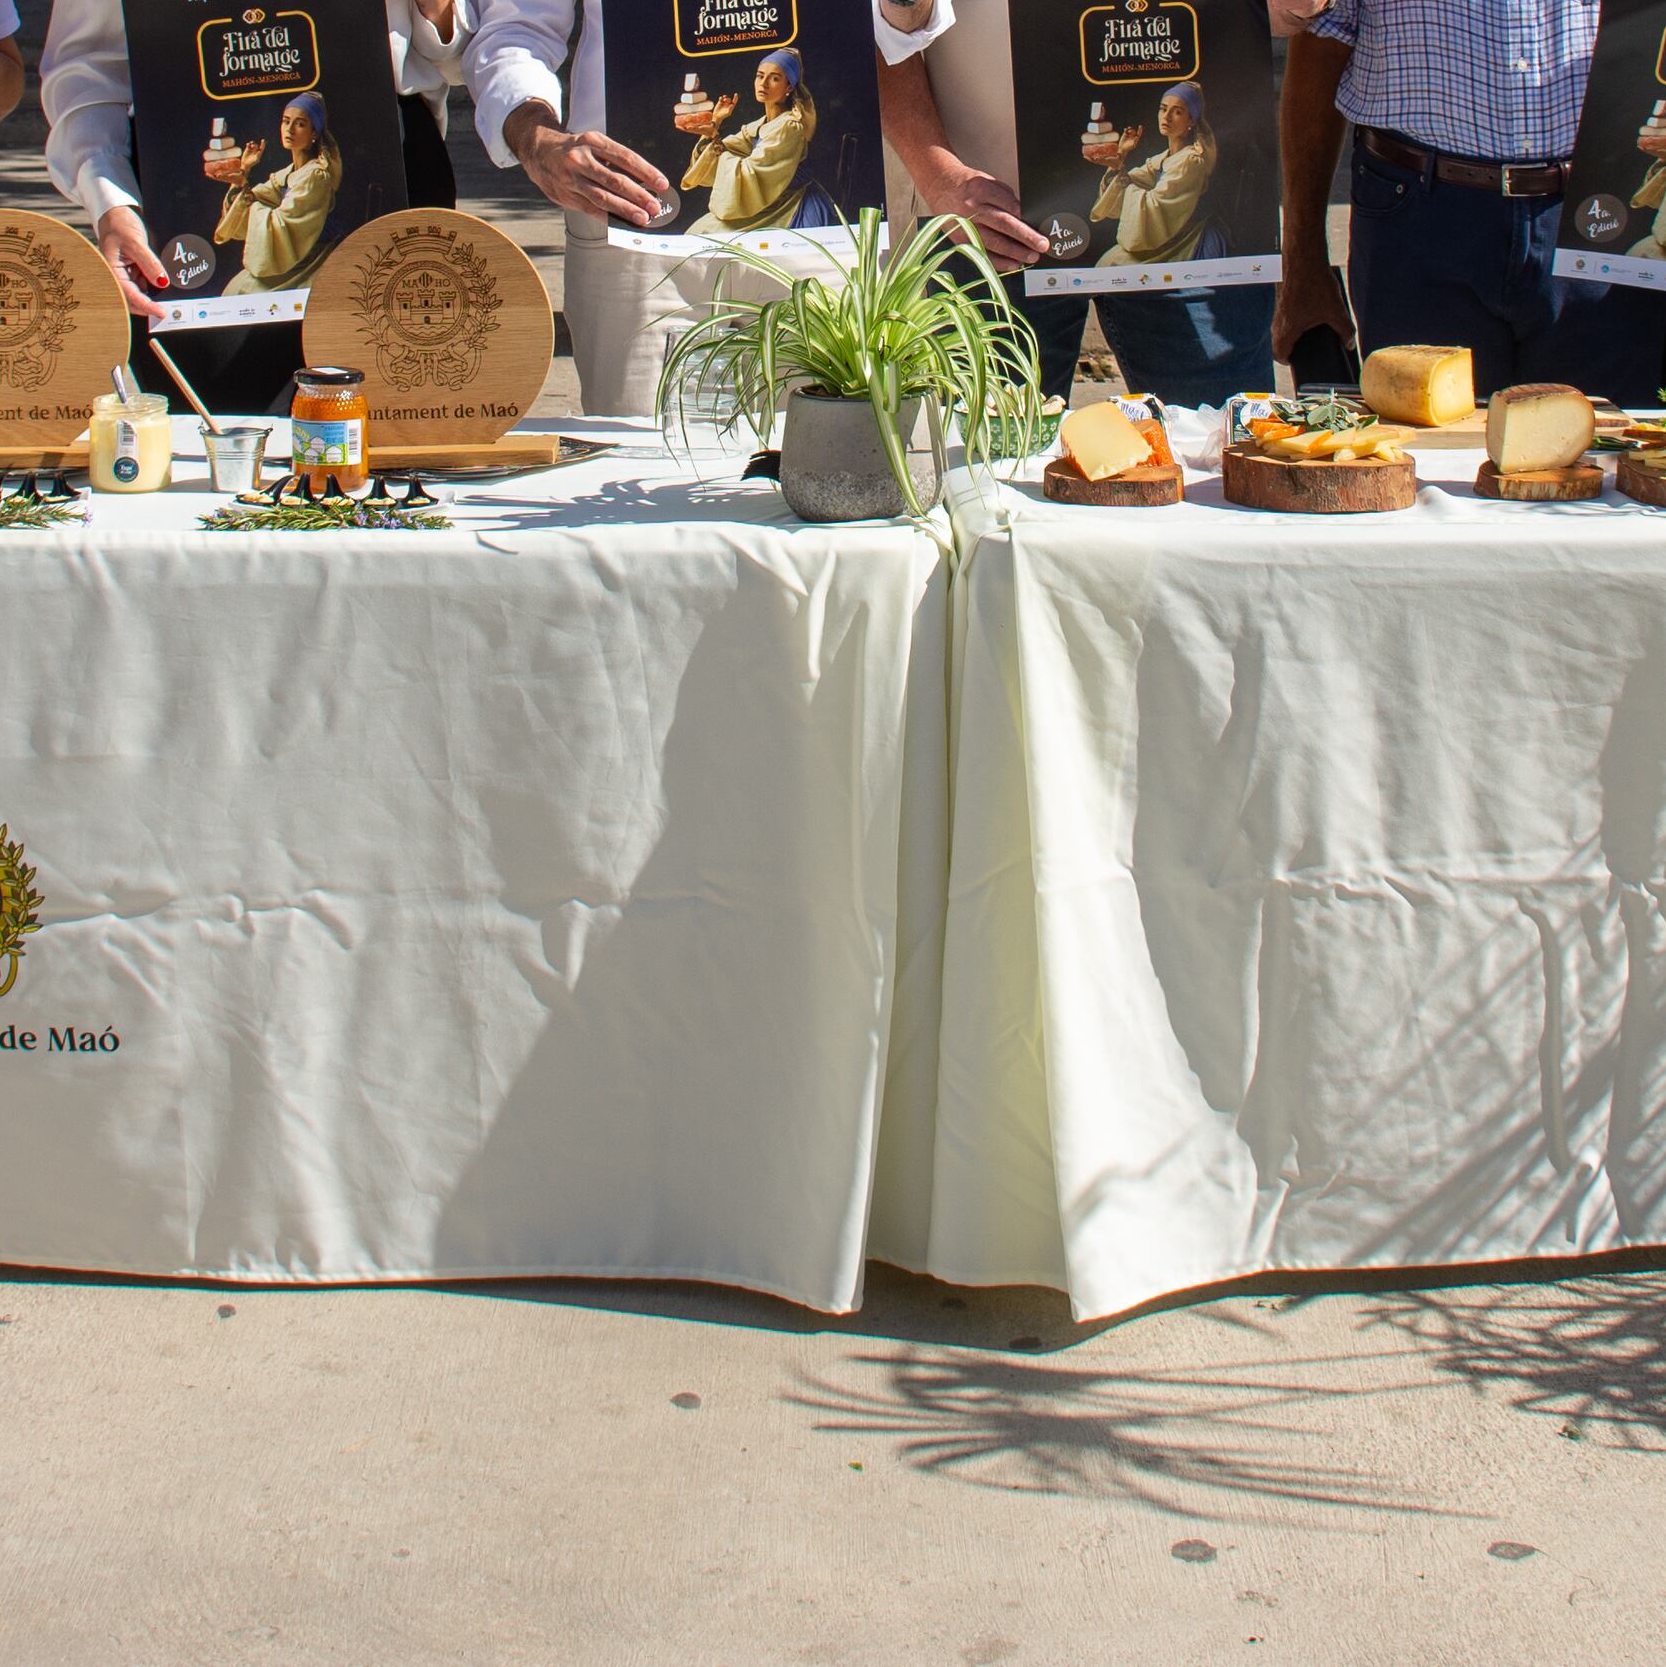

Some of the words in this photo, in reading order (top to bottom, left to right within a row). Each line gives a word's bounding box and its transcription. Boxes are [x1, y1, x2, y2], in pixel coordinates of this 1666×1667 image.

[694, 7, 778, 35] formatge
[1105, 18, 1142, 41] Fira
[1144, 16, 1170, 36] del
[223, 30, 261, 53] Fira
[262, 26, 290, 48] del
[697, 30, 778, 45] MAHÓN-MENORCA
[1100, 37, 1180, 62] formatge
[220, 48, 300, 77] formatge
[1102, 61, 1181, 73] MAHÓN-MENORCA
[222, 72, 301, 88] MAHÓN-MENORCA
[1587, 218, 1619, 238] Edició
[1052, 236, 1083, 257] Edició
[12, 279, 27, 288] HO
[176, 261, 209, 286] Edició
[402, 278, 418, 288] MA
[435, 278, 450, 288] HO
[29, 404, 50, 420] de
[54, 404, 93, 420] Maó
[368, 405, 448, 420] ntament
[454, 403, 475, 418] de
[480, 402, 518, 418] Maó
[47, 1025, 120, 1053] Maó
